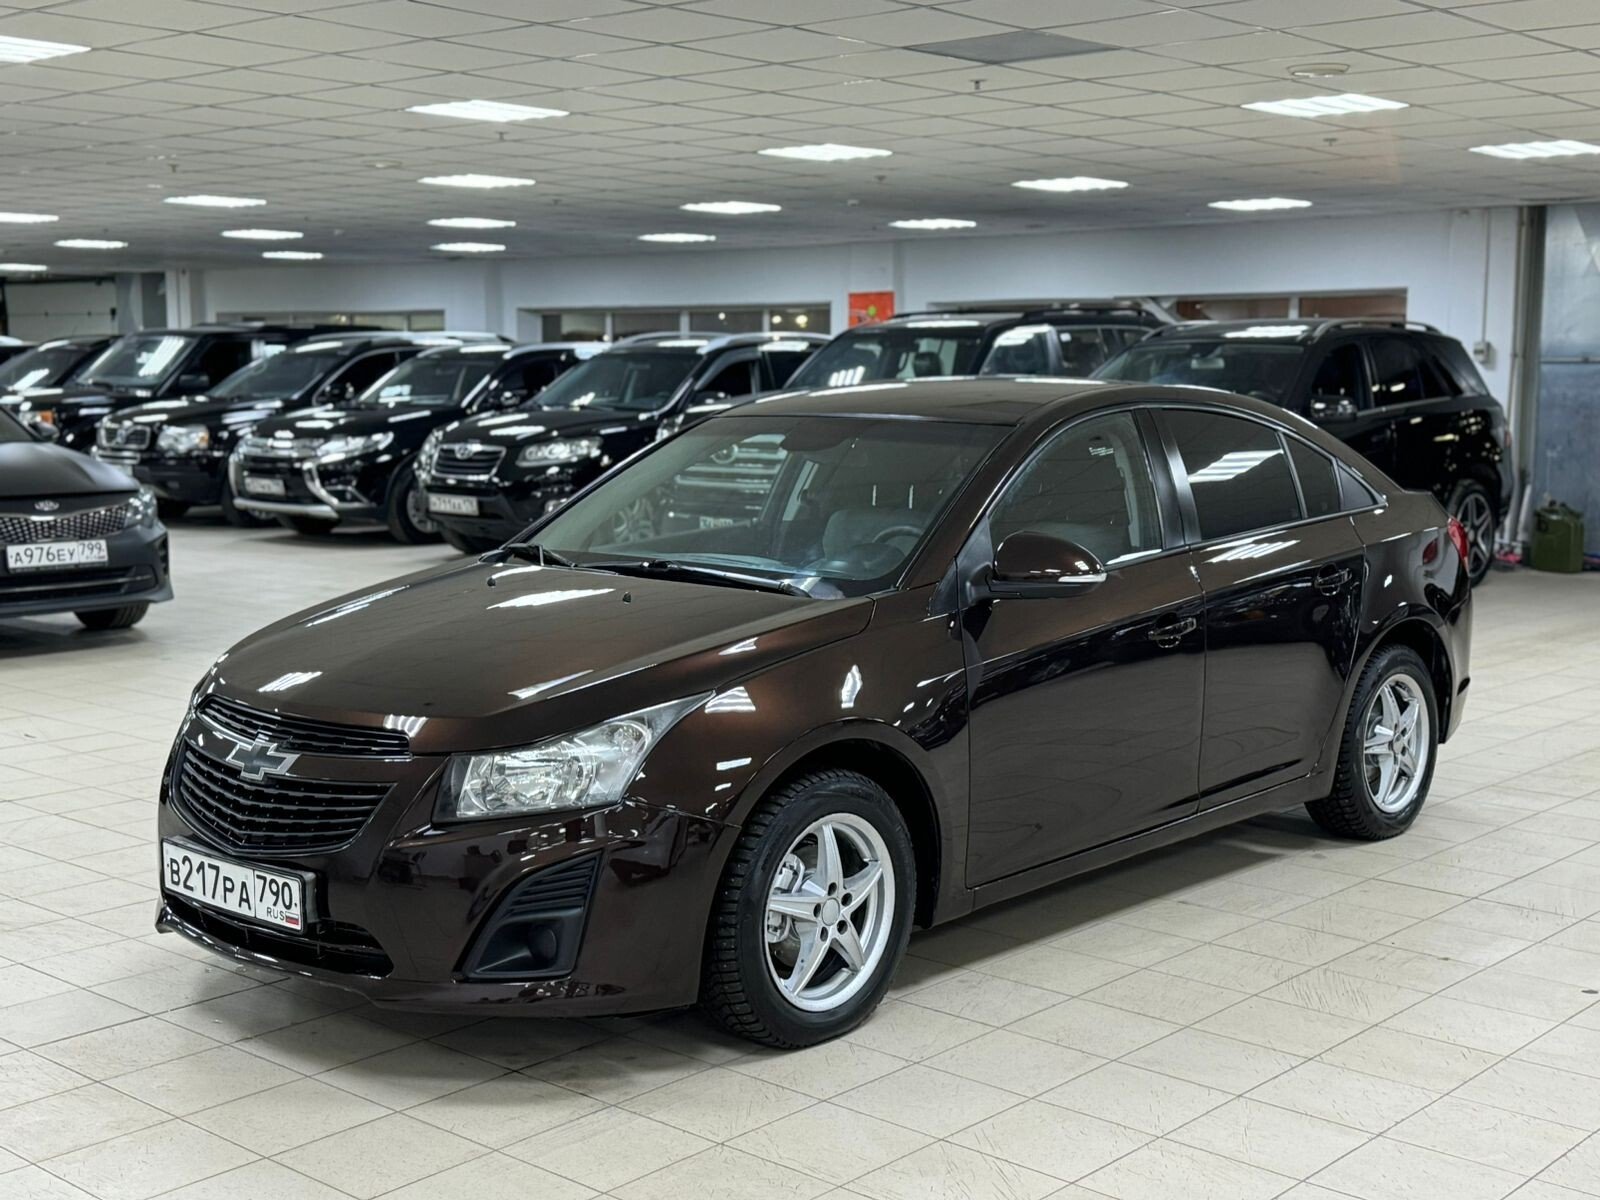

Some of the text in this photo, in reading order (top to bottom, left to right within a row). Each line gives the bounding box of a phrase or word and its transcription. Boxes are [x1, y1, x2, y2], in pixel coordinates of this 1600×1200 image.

[14, 541, 103, 564] А976ЕУ 799
[169, 855, 293, 911] В217РА 790
[266, 906, 285, 921] RUS
